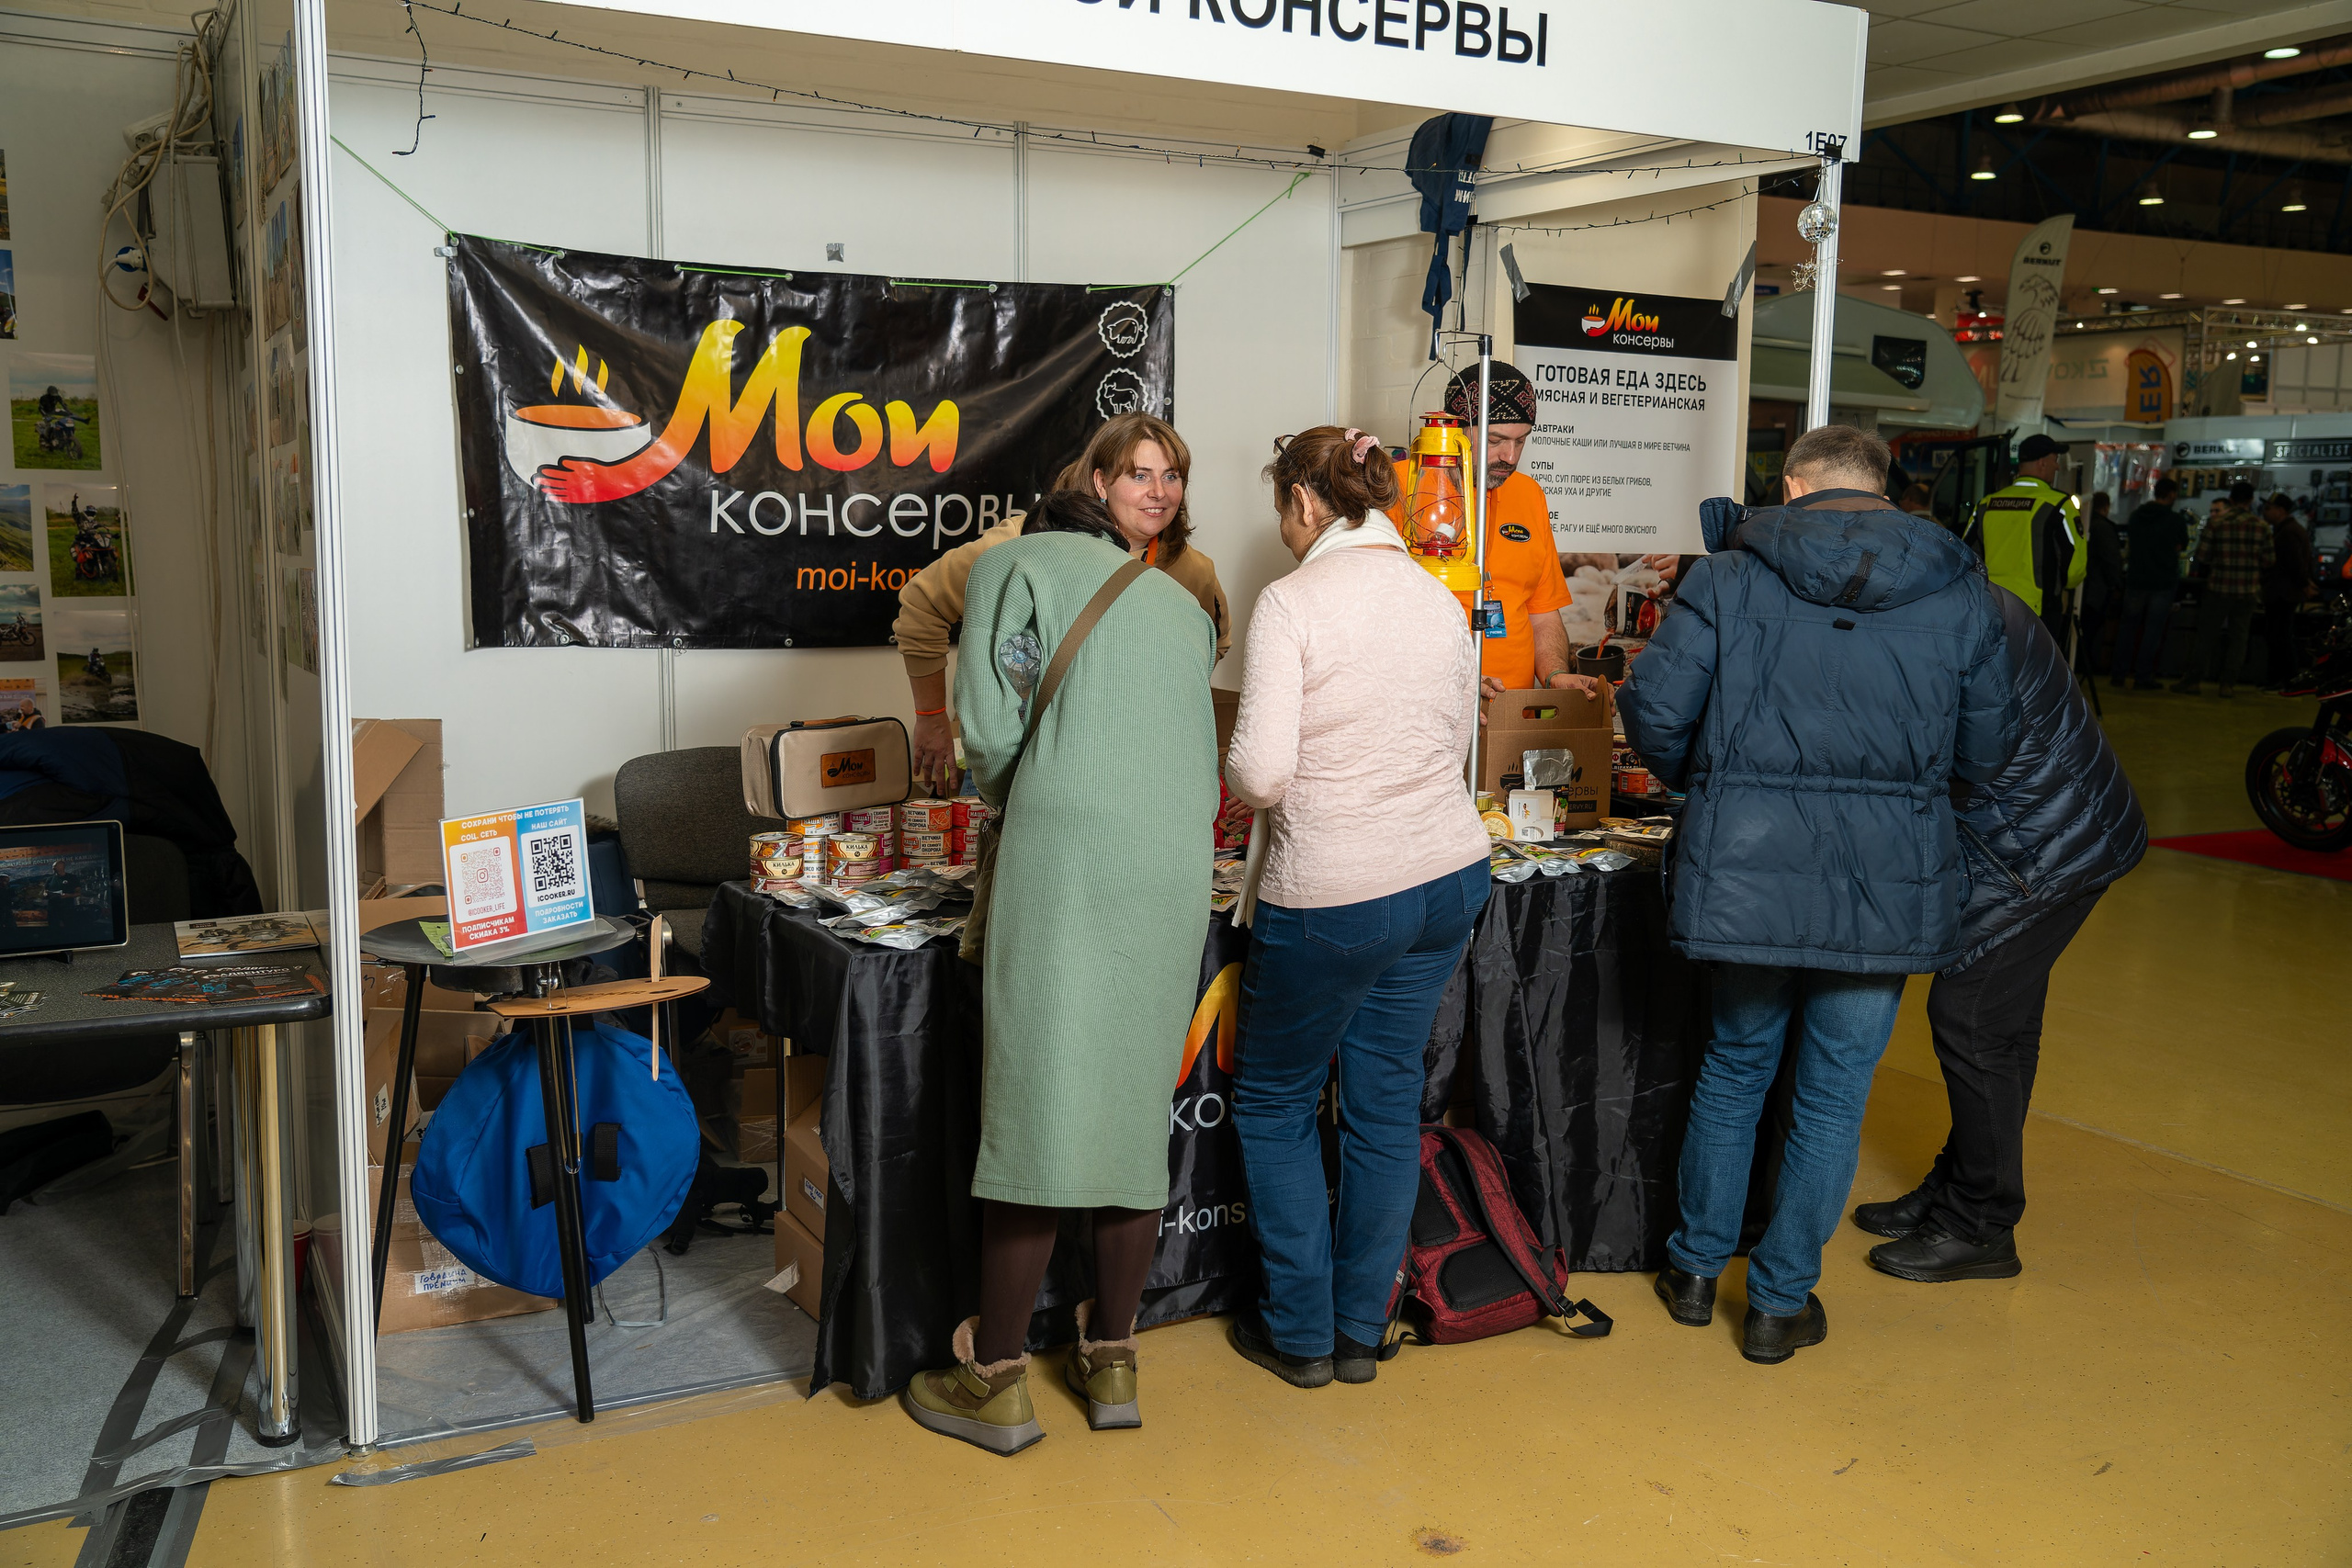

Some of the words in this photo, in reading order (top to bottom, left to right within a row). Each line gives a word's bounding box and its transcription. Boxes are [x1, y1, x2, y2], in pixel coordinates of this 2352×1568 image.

[1608, 297, 1659, 333] Мои
[1612, 333, 1674, 350] консервы
[1536, 364, 1610, 385] ГОТОВАЯ
[1616, 369, 1650, 390] ЕДА
[1655, 372, 1707, 392] ЗДЕСЬ
[662, 319, 961, 474] Мои
[1535, 389, 1586, 404] МЯСНАЯ
[1590, 391, 1598, 405] И
[1602, 393, 1705, 411] ВЕГЕТЕРИАНСКАЯ
[1532, 424, 1575, 434] ЗАВТРАКИ
[1532, 436, 1571, 446] МОЛОЧНЫЕ
[1572, 437, 1592, 447] КАШИ
[1593, 439, 1608, 448] ИЛИ
[1609, 439, 1636, 449] ЛУЧШАЯ
[1637, 441, 1643, 450] В
[1644, 441, 1662, 451] МИРЕ
[1662, 442, 1690, 452] ВЕТЧИНА
[1531, 461, 1555, 470] СУПЫ
[1555, 474, 1569, 483] СУП
[1570, 474, 1590, 484] ПЮРЕ
[1592, 475, 1601, 484] ИЗ
[1602, 476, 1625, 485] БЕЛЫХ
[1625, 477, 1653, 487] ГРИБОВ,
[1565, 487, 1577, 496] УХА
[1578, 488, 1585, 496] И
[1585, 488, 1611, 497] ДРУГИЕ
[1991, 499, 2030, 508] ПОЛИЦИЯ
[710, 490, 1041, 550] консерв
[1560, 524, 1577, 533] РАГУ
[1578, 525, 1584, 533] И
[1585, 523, 1600, 534] ЕЩЁ
[1601, 525, 1623, 534] МНОГО
[1624, 525, 1657, 535] ВКУСНОГО
[461, 817, 497, 829] СОХРАНИ
[498, 812, 523, 823] ЧТОБЫ
[524, 810, 534, 818] НЕ
[535, 805, 570, 817] ПОТЕРЯТЬ
[531, 822, 548, 830] НАШ
[548, 818, 568, 828] САЙТ
[461, 832, 480, 842] СОЦ.
[481, 829, 498, 839] СЕТЬ
[537, 889, 576, 903] ICOOKER.RU
[468, 902, 505, 917] @ICOOKER_LIFE
[535, 900, 583, 917] ПОДРОБНОСТИ
[462, 916, 515, 934] ПОДПИСЧИКАМ
[543, 911, 578, 924] ЗАКАЗАТЬ
[469, 929, 498, 941] СКИДКА
[500, 926, 510, 934] 3%
